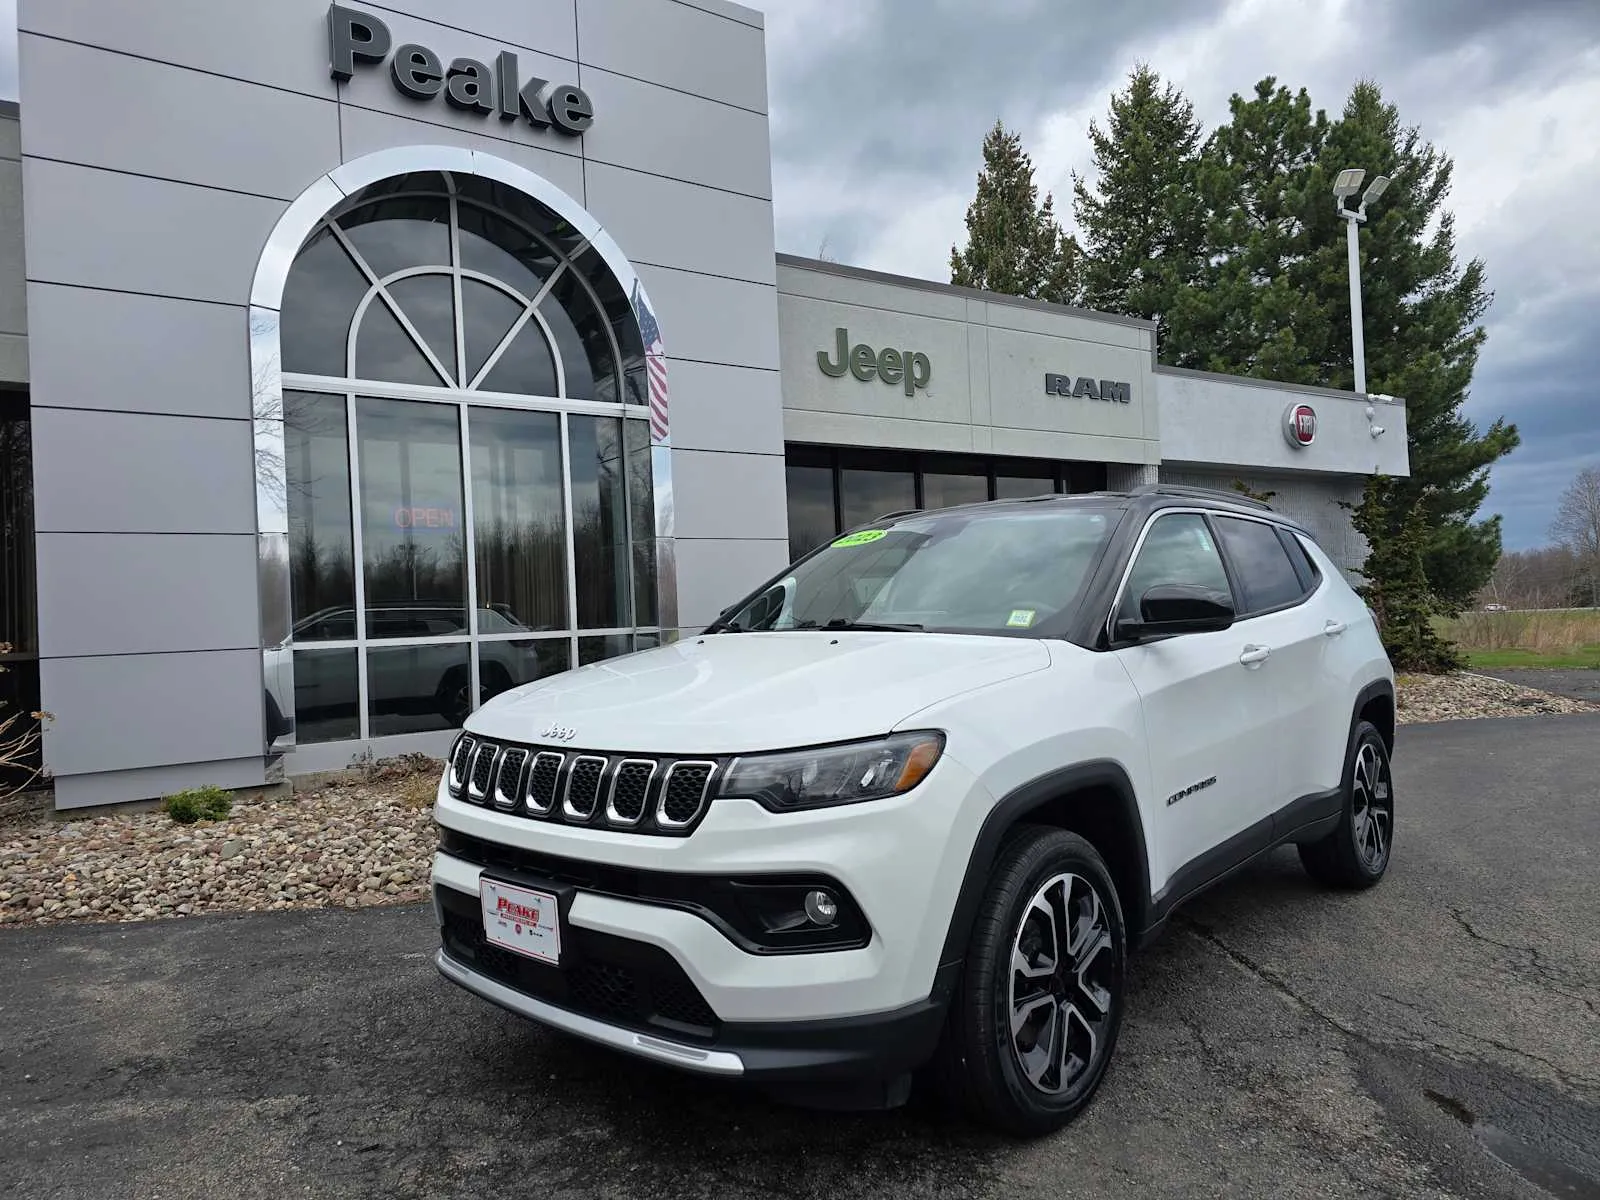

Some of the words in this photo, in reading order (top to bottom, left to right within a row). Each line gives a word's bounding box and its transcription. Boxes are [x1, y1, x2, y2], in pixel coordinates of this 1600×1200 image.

[327, 3, 593, 136] Peake
[817, 327, 931, 397] Jeep
[1045, 373, 1130, 404] RAM
[394, 507, 454, 528] OPEN
[541, 720, 577, 743] Jeep
